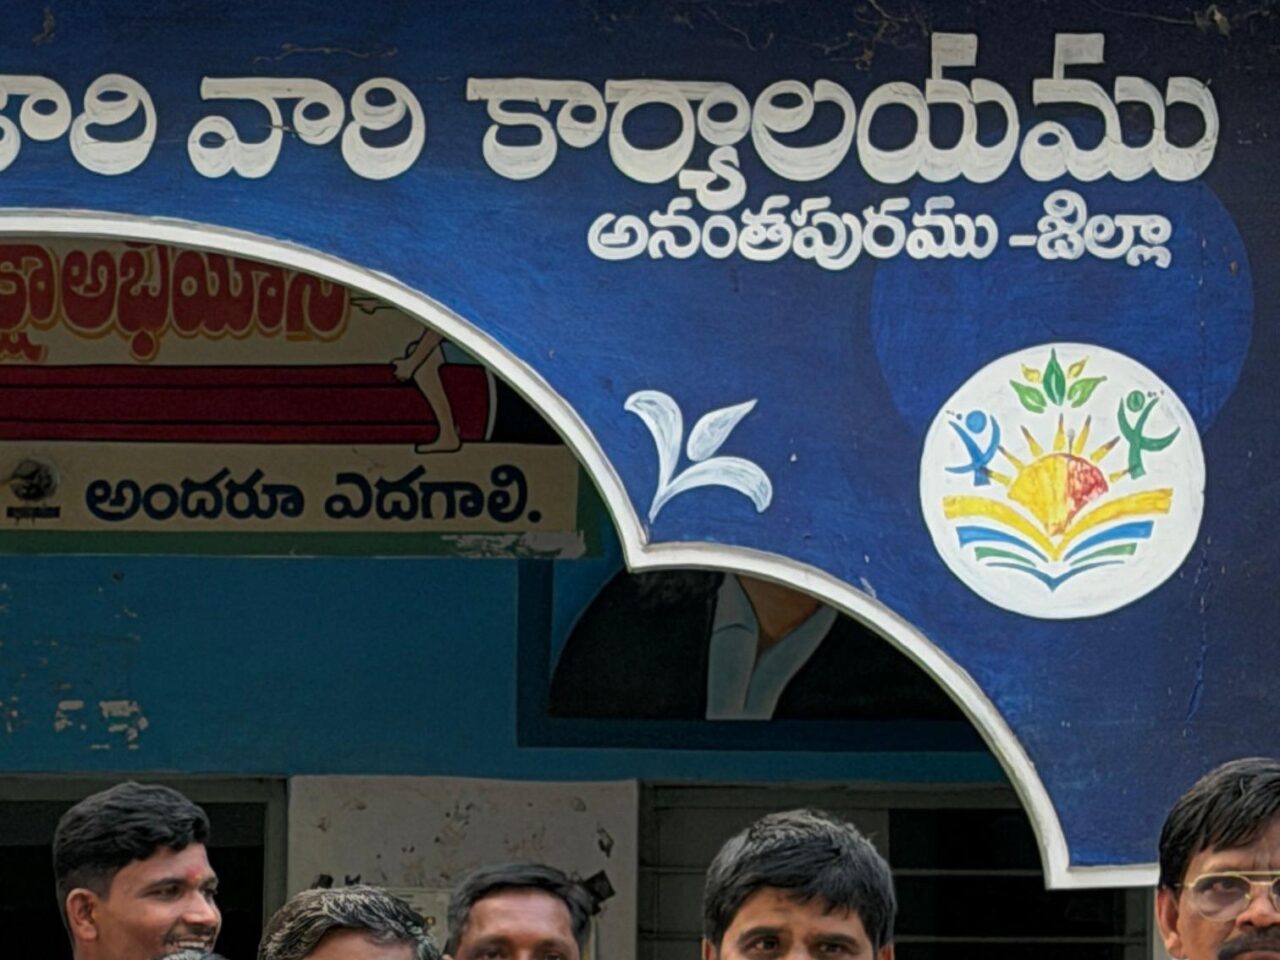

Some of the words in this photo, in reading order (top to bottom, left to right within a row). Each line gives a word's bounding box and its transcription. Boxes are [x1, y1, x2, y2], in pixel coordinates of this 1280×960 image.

[186, 72, 425, 180] వారి
[466, 32, 1220, 208] కార్యాలయము
[587, 196, 999, 270] అనంతపురము
[86, 465, 305, 523] అందరూ
[323, 464, 543, 523] ఎదగాలి.
